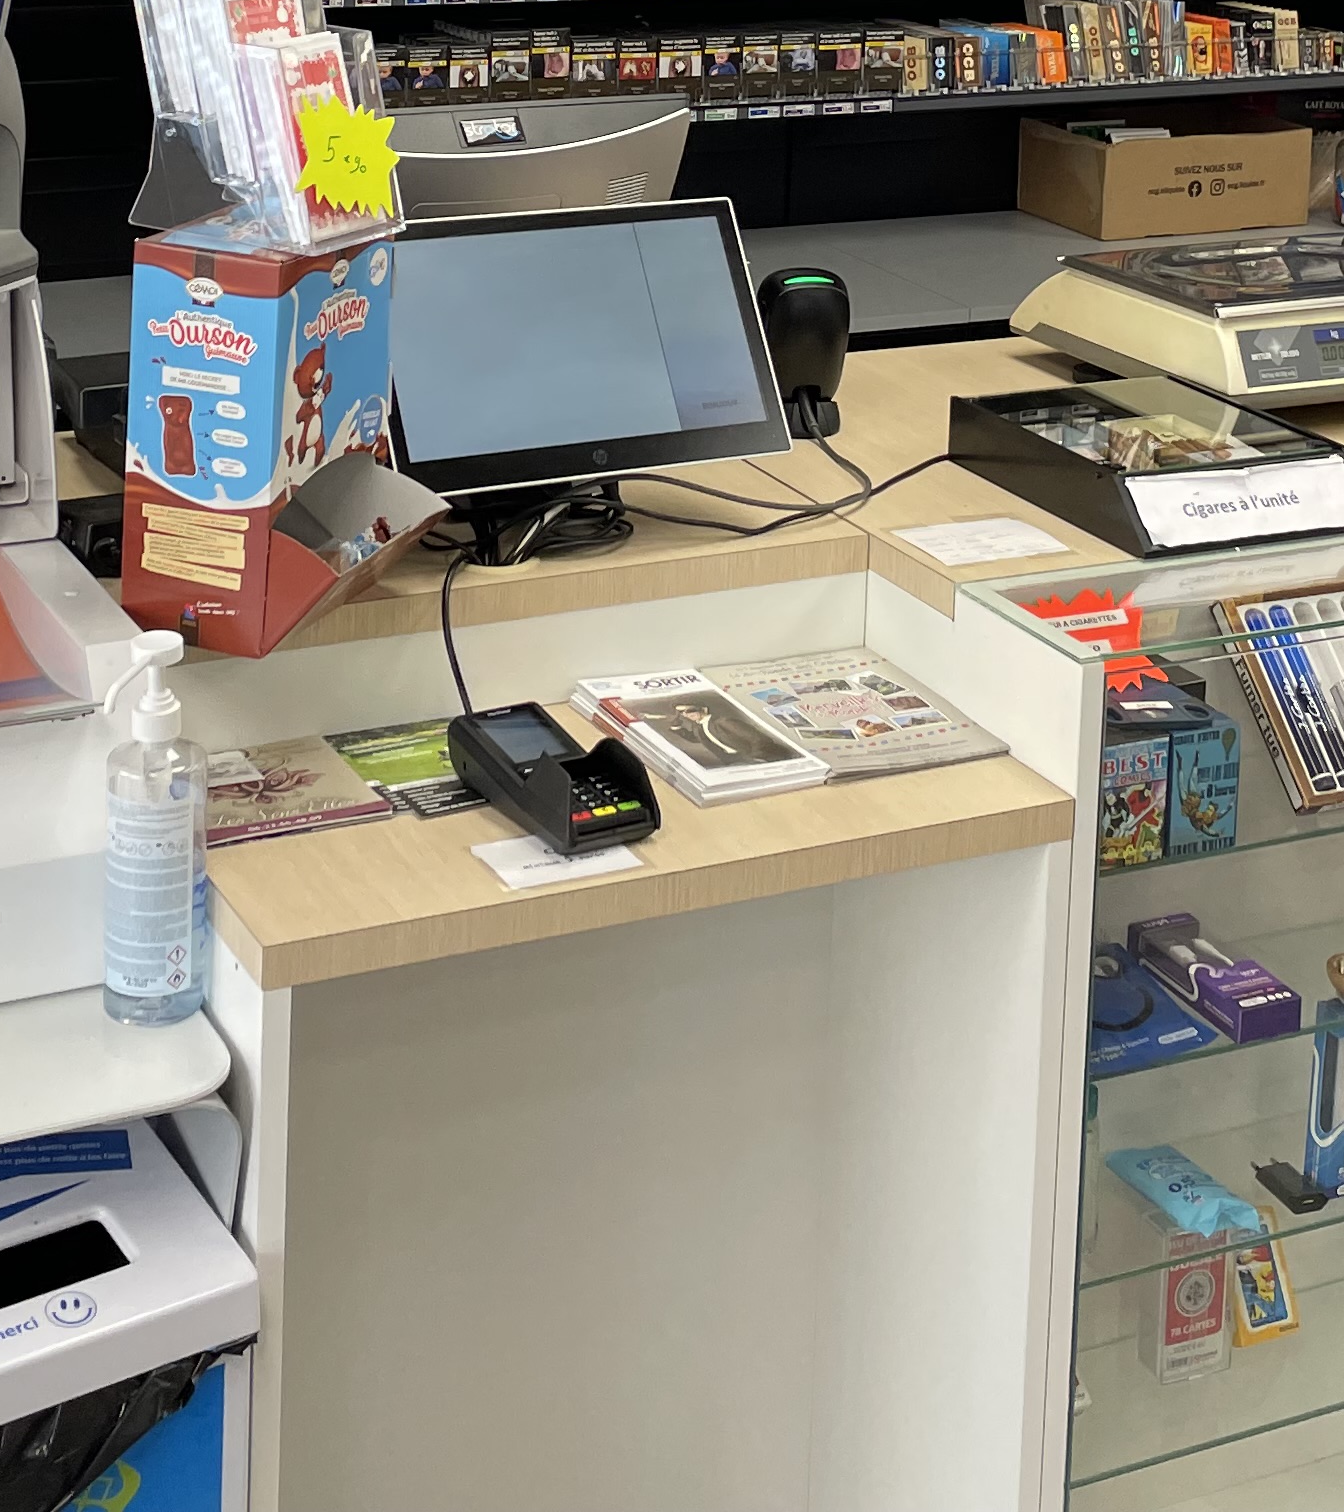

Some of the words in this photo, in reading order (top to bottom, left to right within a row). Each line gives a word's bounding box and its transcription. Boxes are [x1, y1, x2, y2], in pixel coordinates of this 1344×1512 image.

[1277, 17, 1297, 27] OCB
[906, 44, 918, 82] OCB
[934, 45, 947, 81] OCB
[961, 42, 975, 83] OCB
[1174, 162, 1203, 176] SUIVEZ
[1204, 161, 1226, 174] NOUS
[1227, 160, 1244, 173] SUR
[176, 312, 233, 329] L'Authentique
[317, 296, 370, 339] Ourson
[169, 319, 256, 356] Ourson
[1182, 497, 1237, 520] Cigares
[1238, 494, 1249, 510] à
[1250, 488, 1300, 509] l'unité
[632, 673, 702, 692] SORTIR
[1102, 750, 1166, 775] BEST
